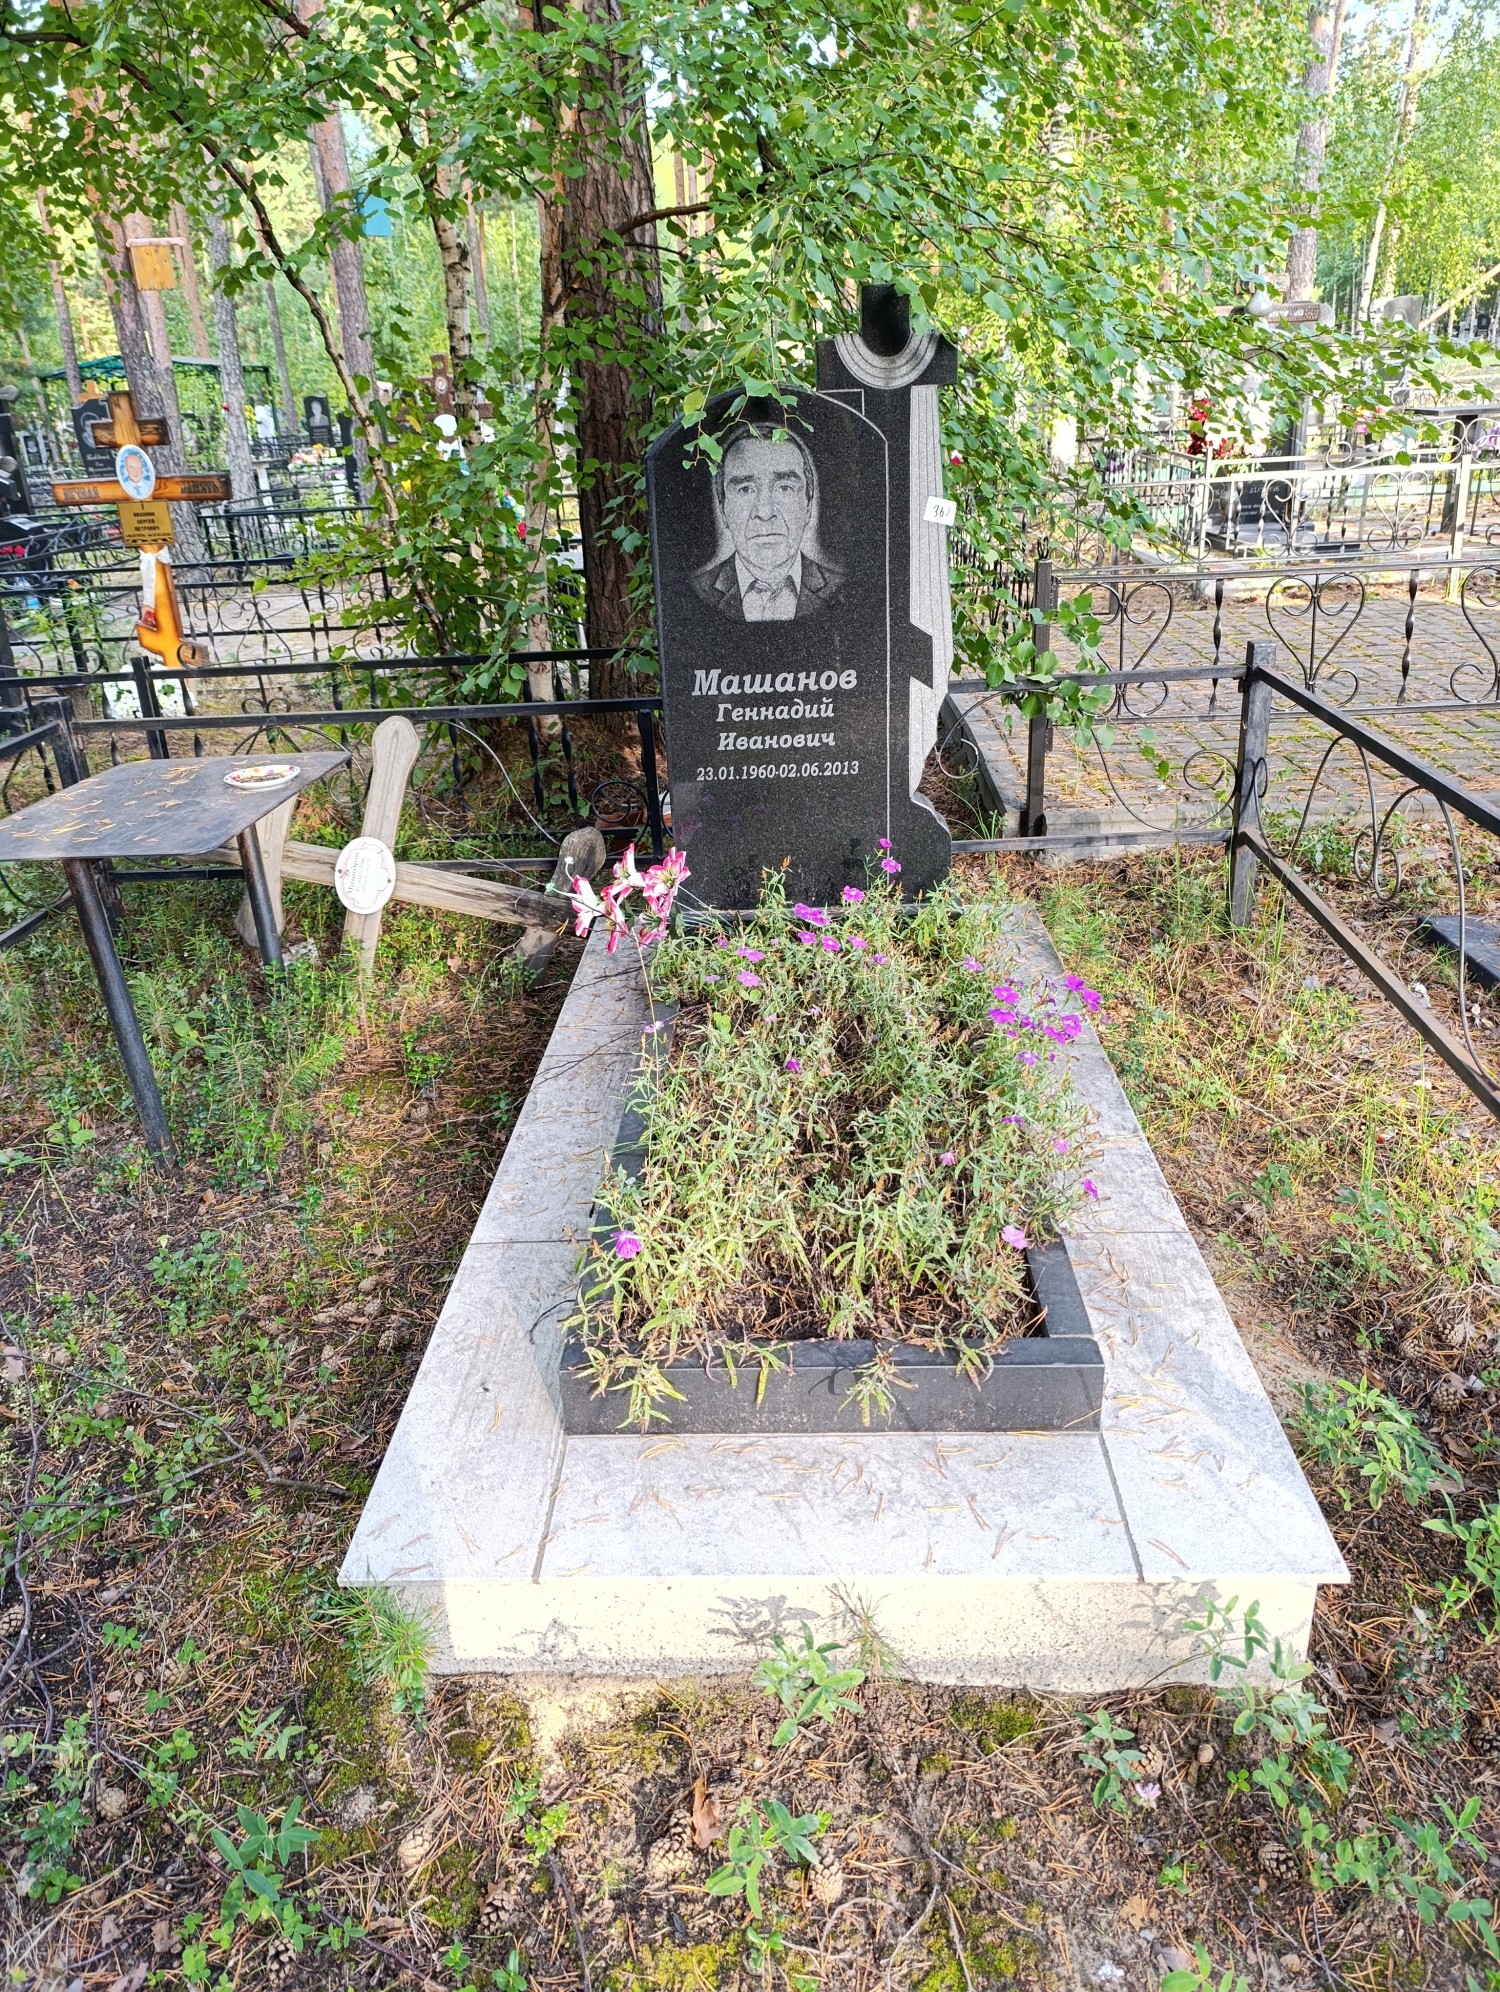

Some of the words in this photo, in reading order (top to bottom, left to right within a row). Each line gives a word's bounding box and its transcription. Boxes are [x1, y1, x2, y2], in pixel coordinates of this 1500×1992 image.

[692, 668, 858, 696] Машанов
[716, 698, 835, 722] Геннадий
[717, 731, 836, 751] Иванович
